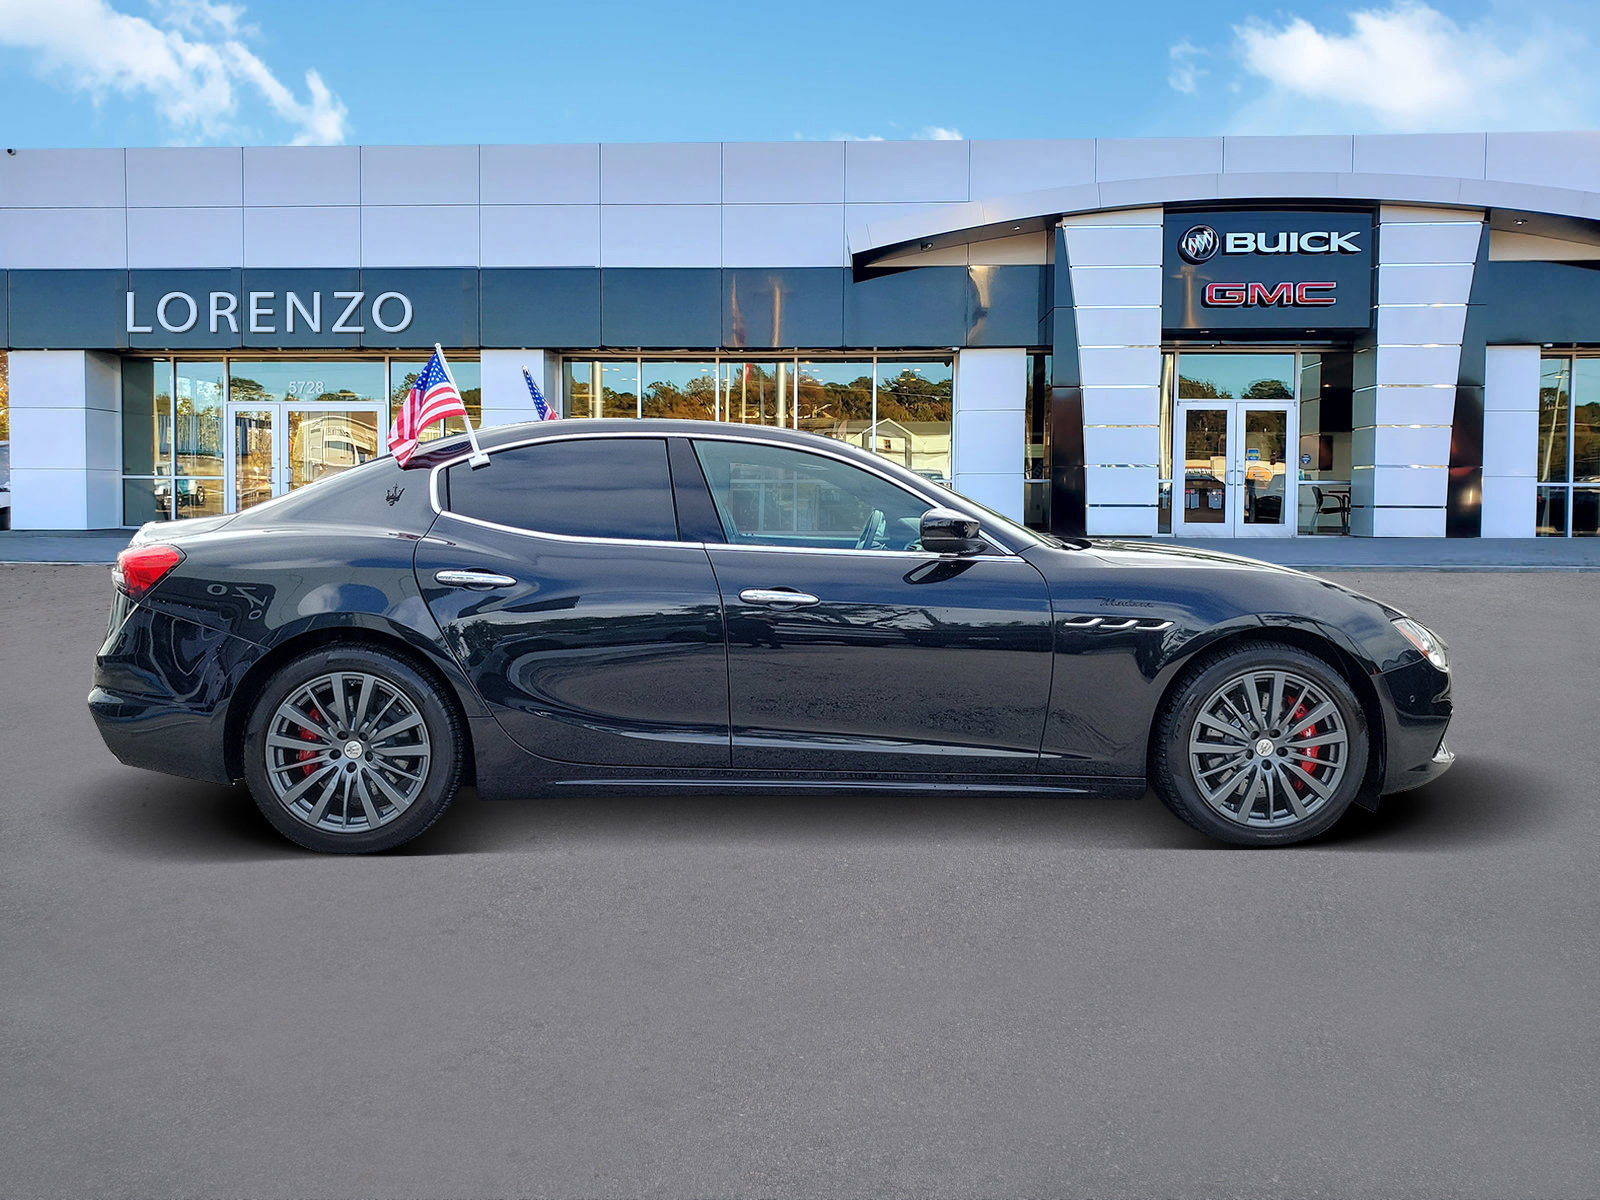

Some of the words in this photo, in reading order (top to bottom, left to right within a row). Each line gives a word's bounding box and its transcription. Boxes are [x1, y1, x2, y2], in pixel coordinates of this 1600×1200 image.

[1225, 231, 1362, 253] BUICK
[1206, 282, 1337, 306] GMC
[126, 291, 413, 333] LORENZO
[288, 380, 325, 394] 5728
